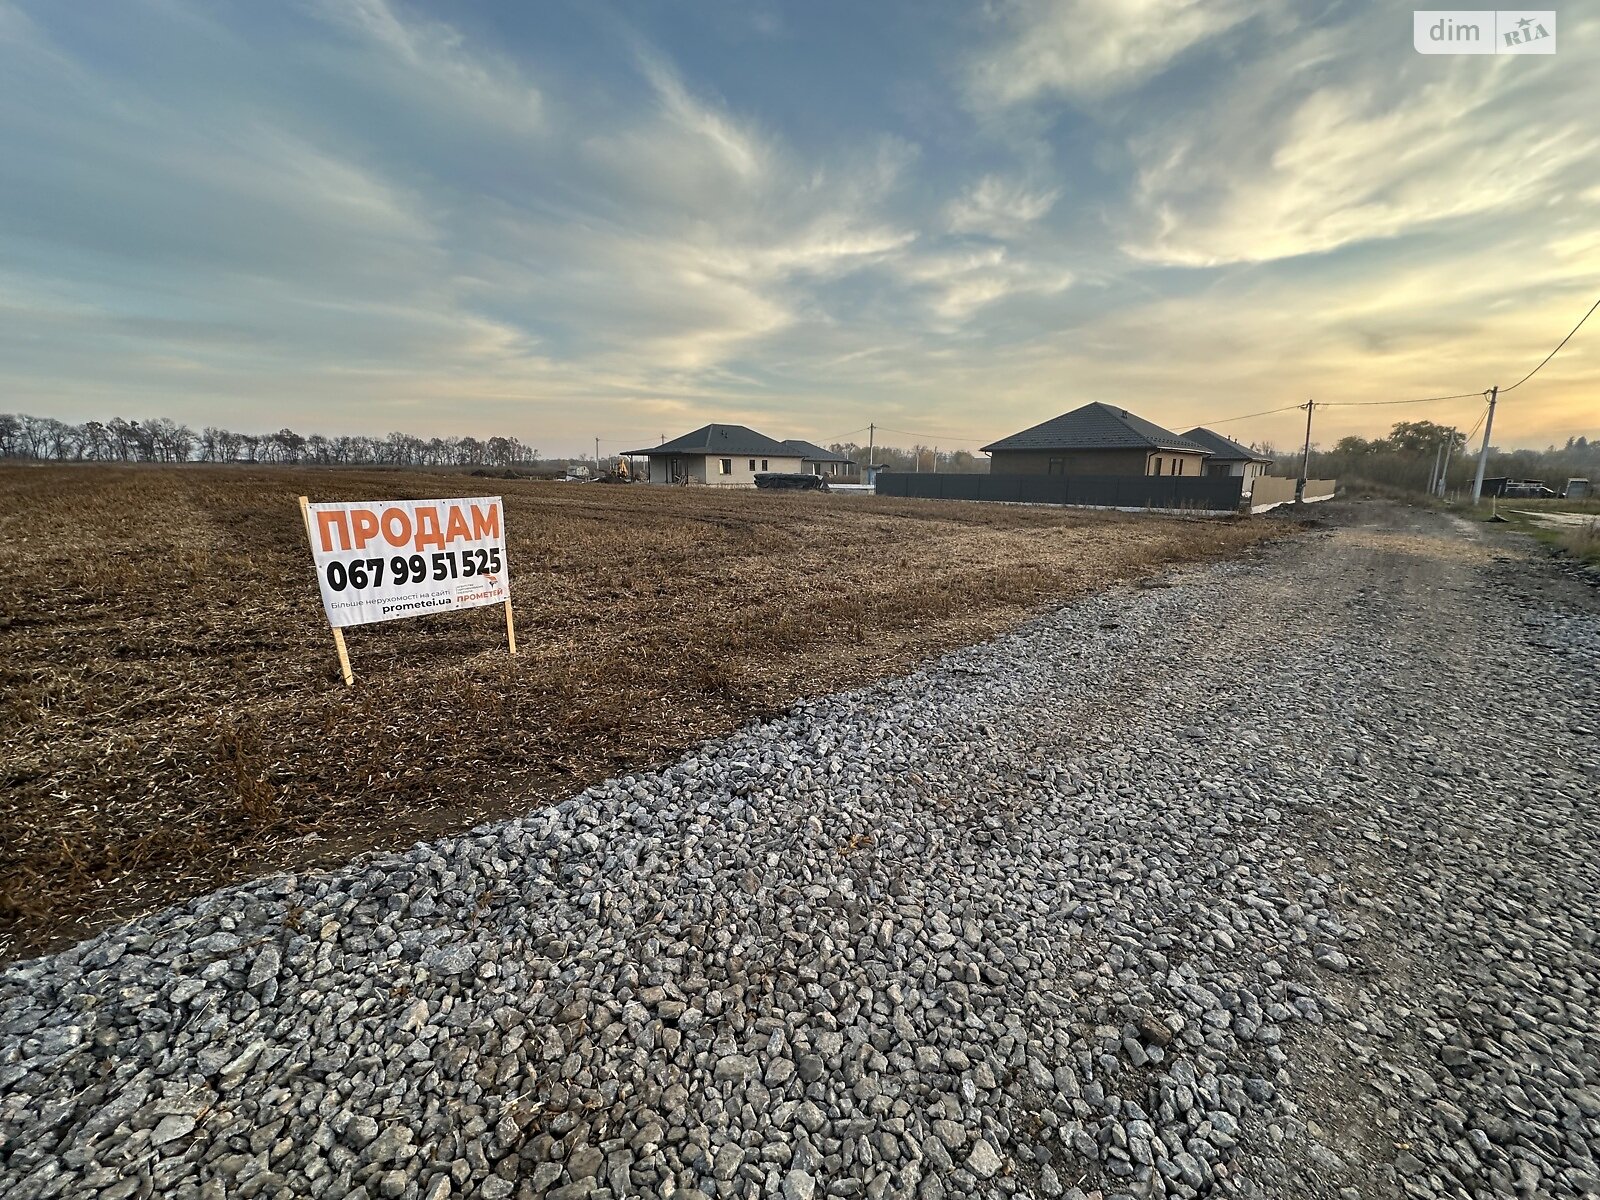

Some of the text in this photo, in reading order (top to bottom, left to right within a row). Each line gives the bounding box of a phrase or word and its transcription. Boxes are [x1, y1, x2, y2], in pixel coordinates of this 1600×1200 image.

[316, 503, 500, 552] ПРОДАМ
[326, 547, 501, 591] 067 99 51 525
[330, 599, 364, 610] Більше
[365, 592, 419, 606] нерухомості
[431, 589, 451, 597] сайті
[382, 597, 452, 614] prometei.ua
[456, 588, 503, 602] ПРОМЕТЕЙ
